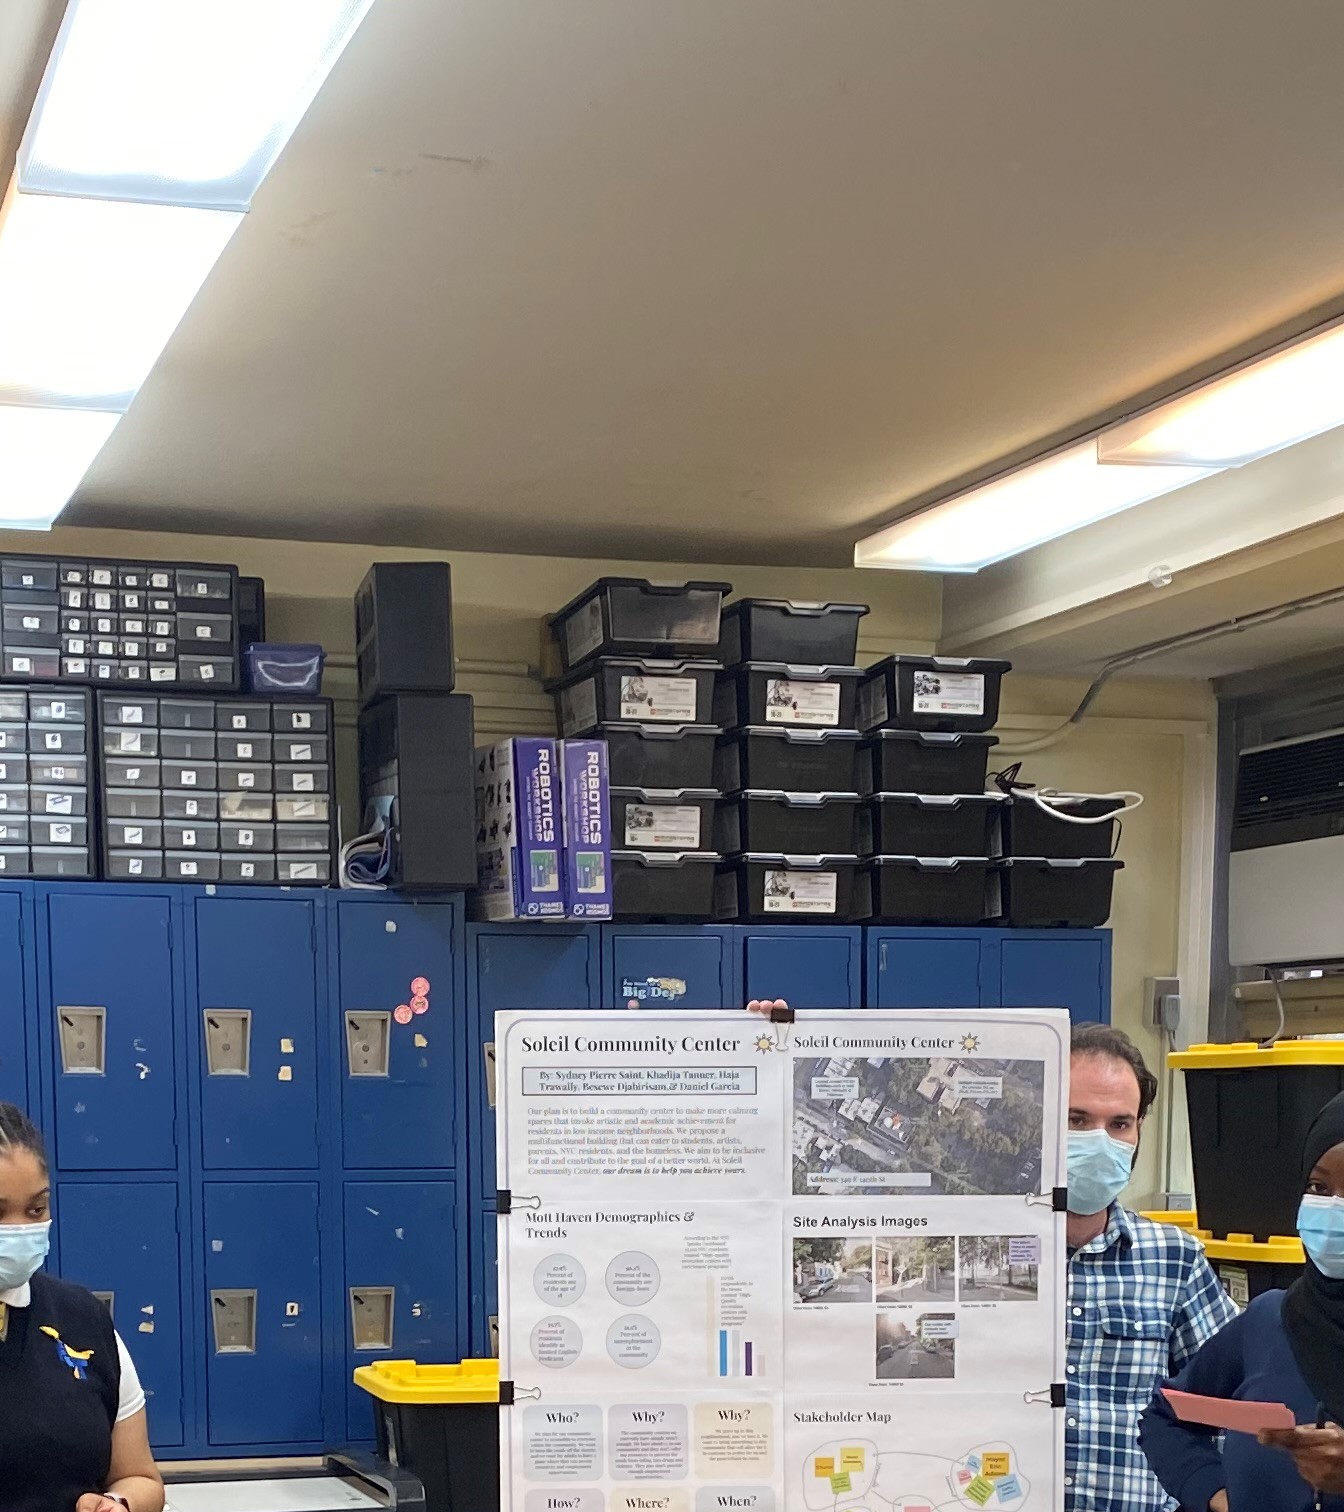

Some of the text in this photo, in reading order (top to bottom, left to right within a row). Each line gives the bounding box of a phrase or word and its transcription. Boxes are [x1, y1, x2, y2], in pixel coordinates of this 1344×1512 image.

[538, 749, 554, 842] ROBOTICS
[587, 752, 601, 844] ROBOTICS
[531, 768, 542, 842] WORKSHOP
[579, 770, 589, 844] WORKSHOP
[623, 987, 646, 999] Big
[521, 1035, 741, 1055] Soleil Community Center
[794, 1035, 955, 1050] Soleil Community Center
[680, 1083, 709, 1091] Daniel
[711, 1083, 740, 1091] Garcia
[525, 1211, 695, 1224] Mott Haven Demographics &
[793, 1215, 928, 1229] Site Analysis Images
[525, 1227, 567, 1239] Trends
[546, 1412, 580, 1424] Who?
[632, 1411, 665, 1425] Why?
[718, 1410, 751, 1423] Why?
[793, 1411, 892, 1424] Stakeholder Map
[547, 1497, 581, 1509] How?
[625, 1497, 670, 1509] Where?
[717, 1495, 757, 1507] When?
